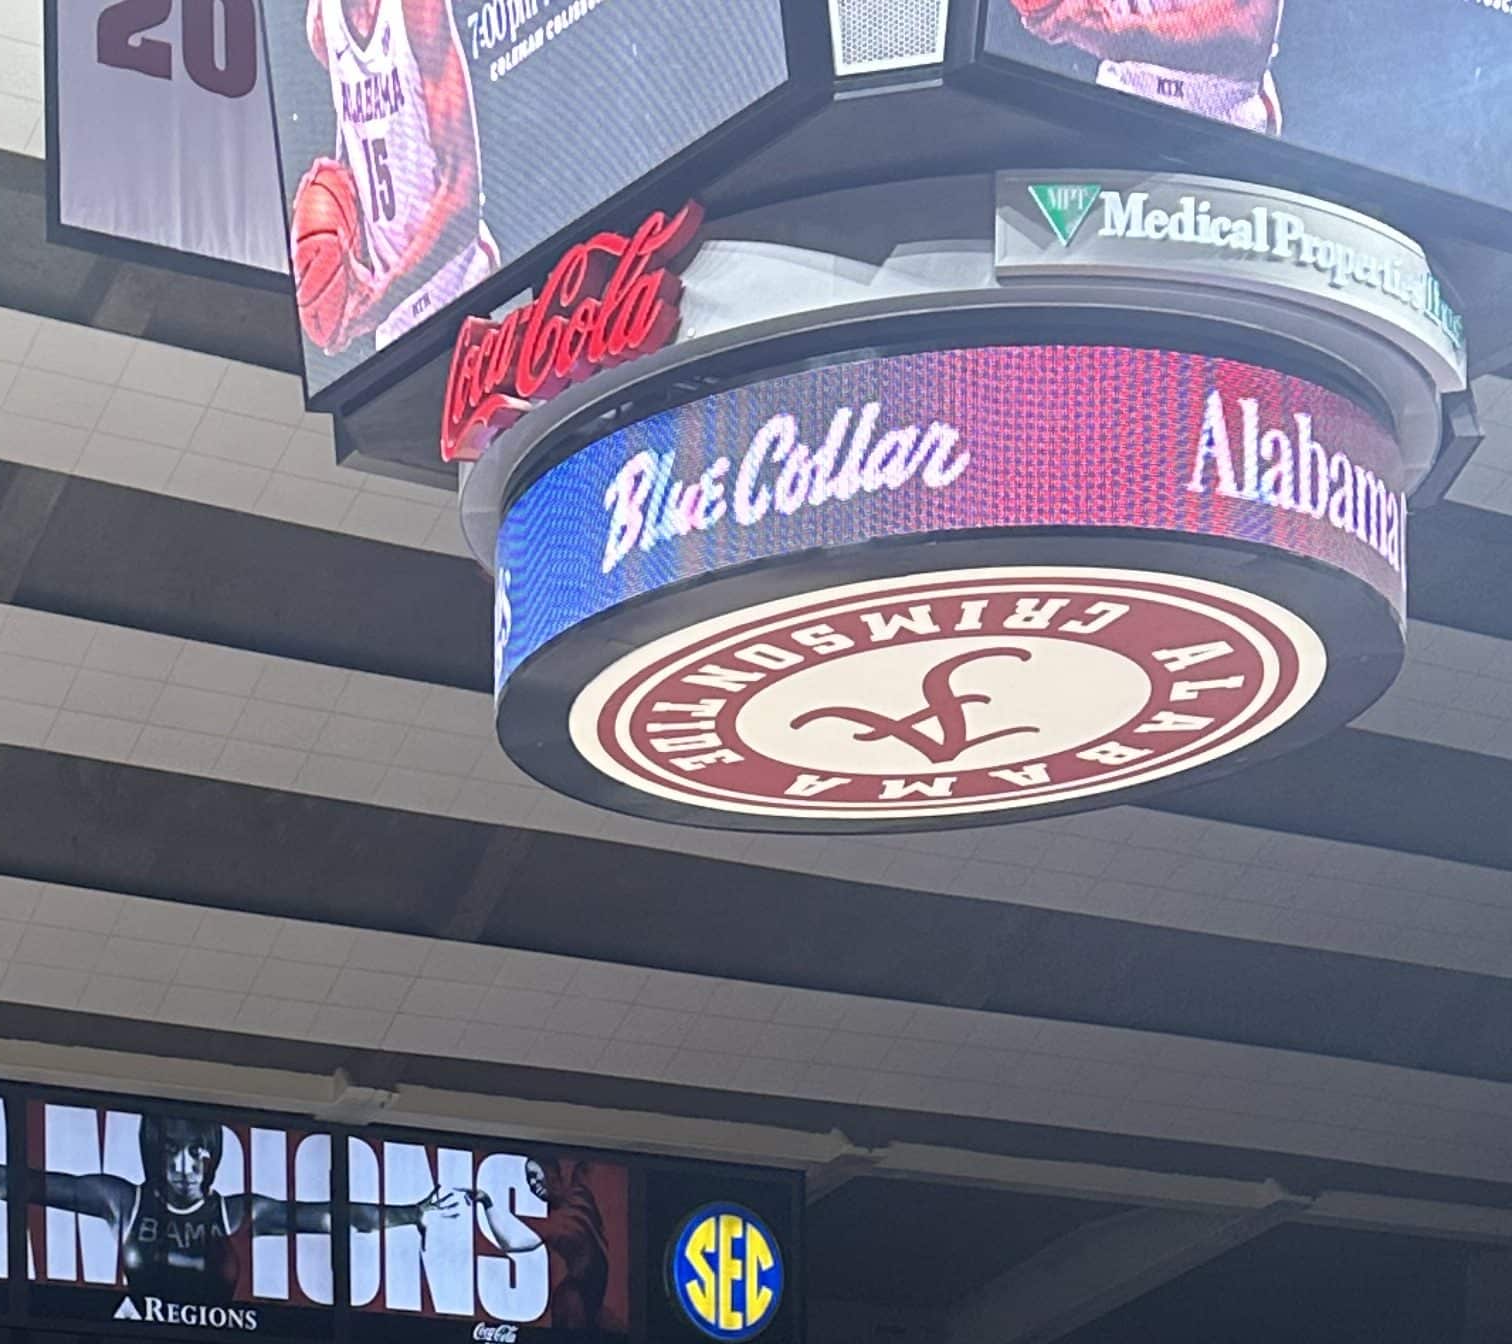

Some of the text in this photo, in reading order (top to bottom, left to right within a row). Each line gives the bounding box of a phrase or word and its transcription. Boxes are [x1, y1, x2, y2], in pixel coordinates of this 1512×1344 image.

[97, 0, 257, 98] 20
[361, 138, 396, 222] 15
[1098, 191, 1270, 254] Medical
[441, 200, 702, 462] Coca-Cola
[602, 402, 970, 574] Blue Collar
[1186, 388, 1402, 572] Alabama
[644, 598, 1131, 772] CRIMSON TIDE
[785, 640, 1246, 800] ALABAMA
[684, 1213, 776, 1331] SEC
